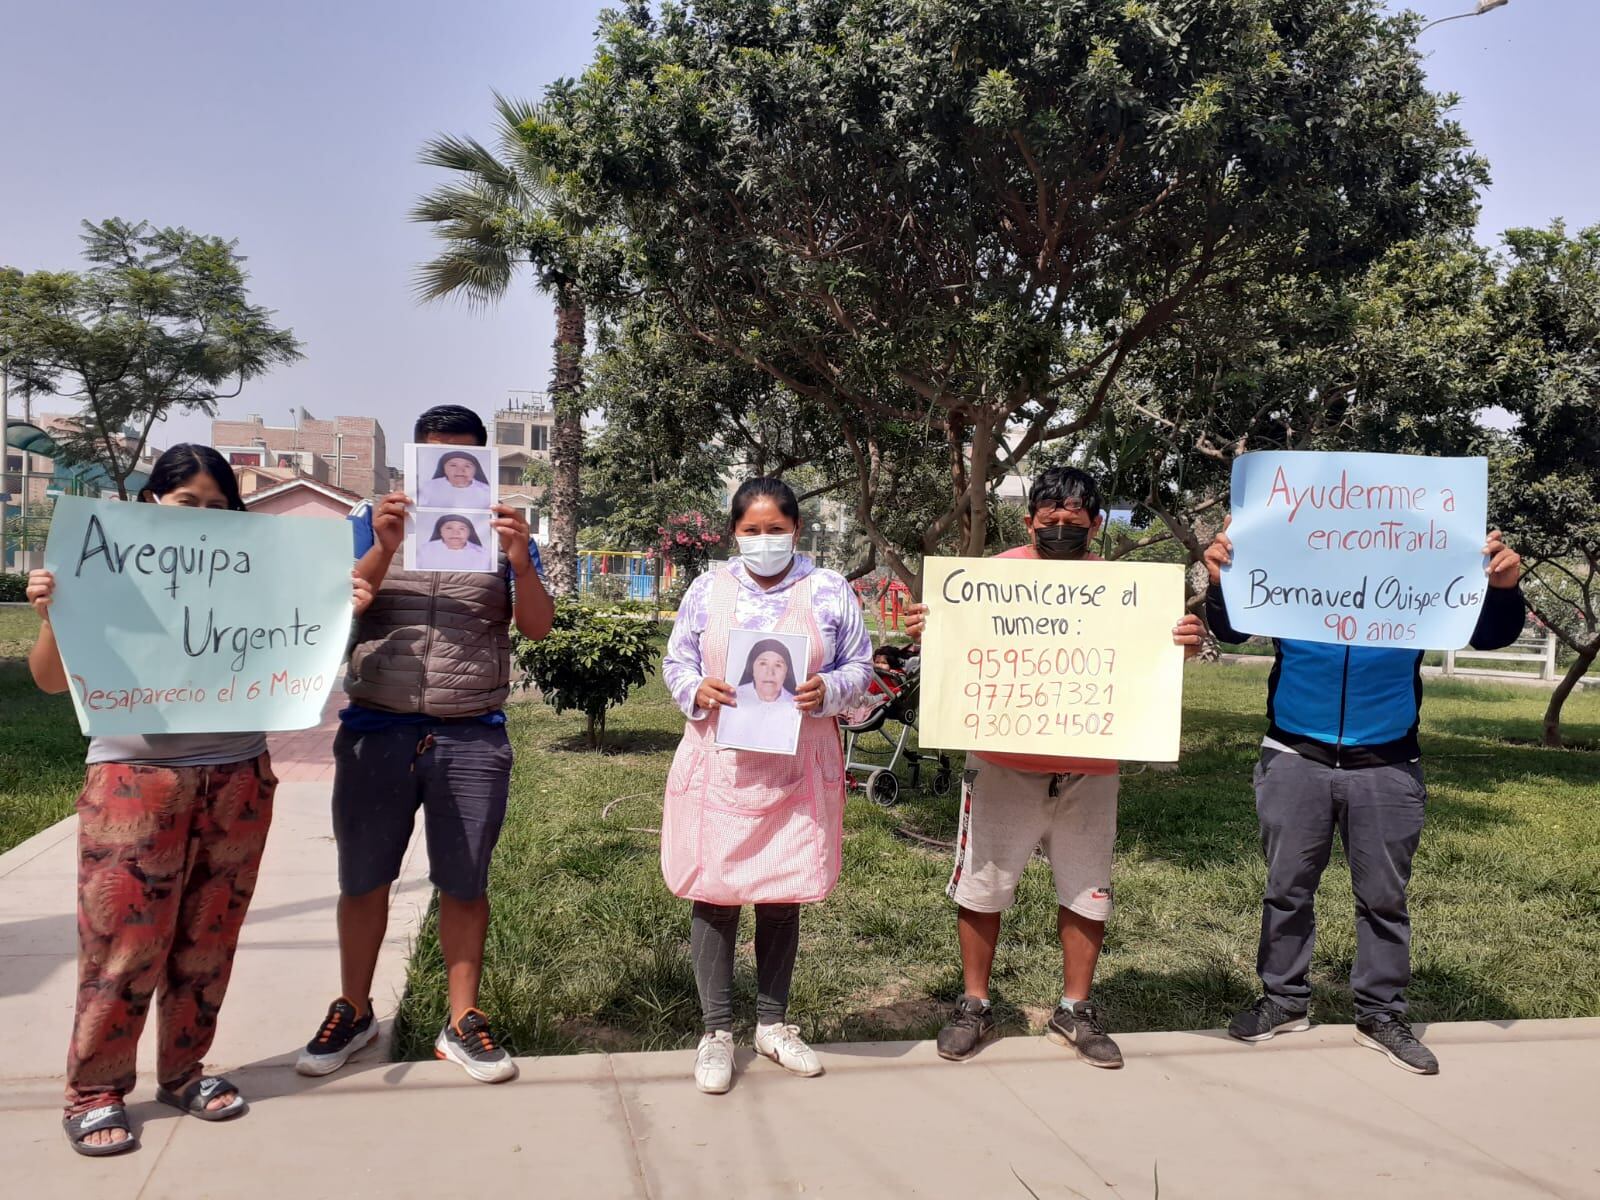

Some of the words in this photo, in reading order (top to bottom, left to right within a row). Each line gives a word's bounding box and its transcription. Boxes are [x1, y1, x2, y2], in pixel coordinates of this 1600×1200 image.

[1440, 487, 1457, 513] a
[75, 514, 252, 600] Arequipa
[942, 567, 1106, 608] Comunicarse
[1121, 581, 1138, 608] al
[184, 606, 323, 672] Urgente
[1324, 613, 1357, 641] 90
[967, 647, 1116, 680] 959560007
[217, 674, 236, 703] el
[246, 680, 261, 701] 6
[270, 669, 325, 703] Mayo
[963, 681, 1114, 710] 977567321
[963, 712, 1115, 740] 930024502
[86, 1105, 113, 1121] NIKE
